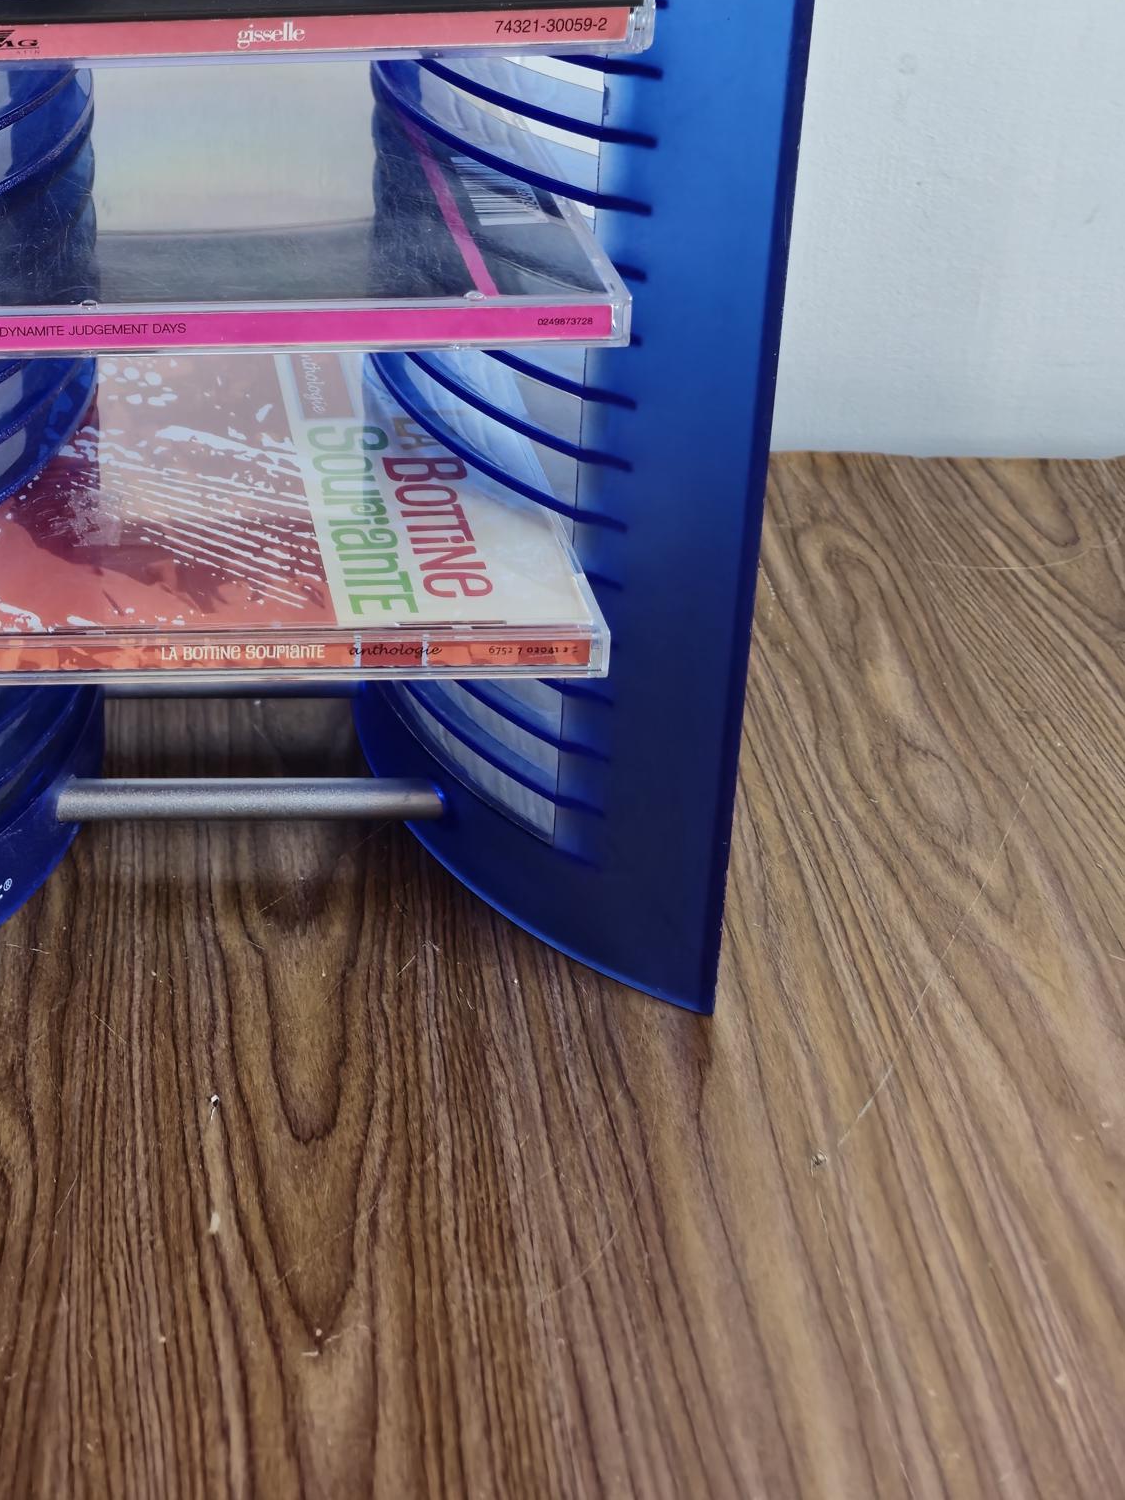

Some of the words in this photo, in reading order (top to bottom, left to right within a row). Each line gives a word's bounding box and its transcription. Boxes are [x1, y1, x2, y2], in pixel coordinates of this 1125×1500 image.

[494, 17, 608, 34] 74321-30059-2
[237, 20, 306, 49] gisselle
[68, 323, 148, 336] JUDGEMENT
[152, 322, 187, 334] DAYS
[161, 645, 178, 661] LA
[349, 643, 442, 659] anthologie
